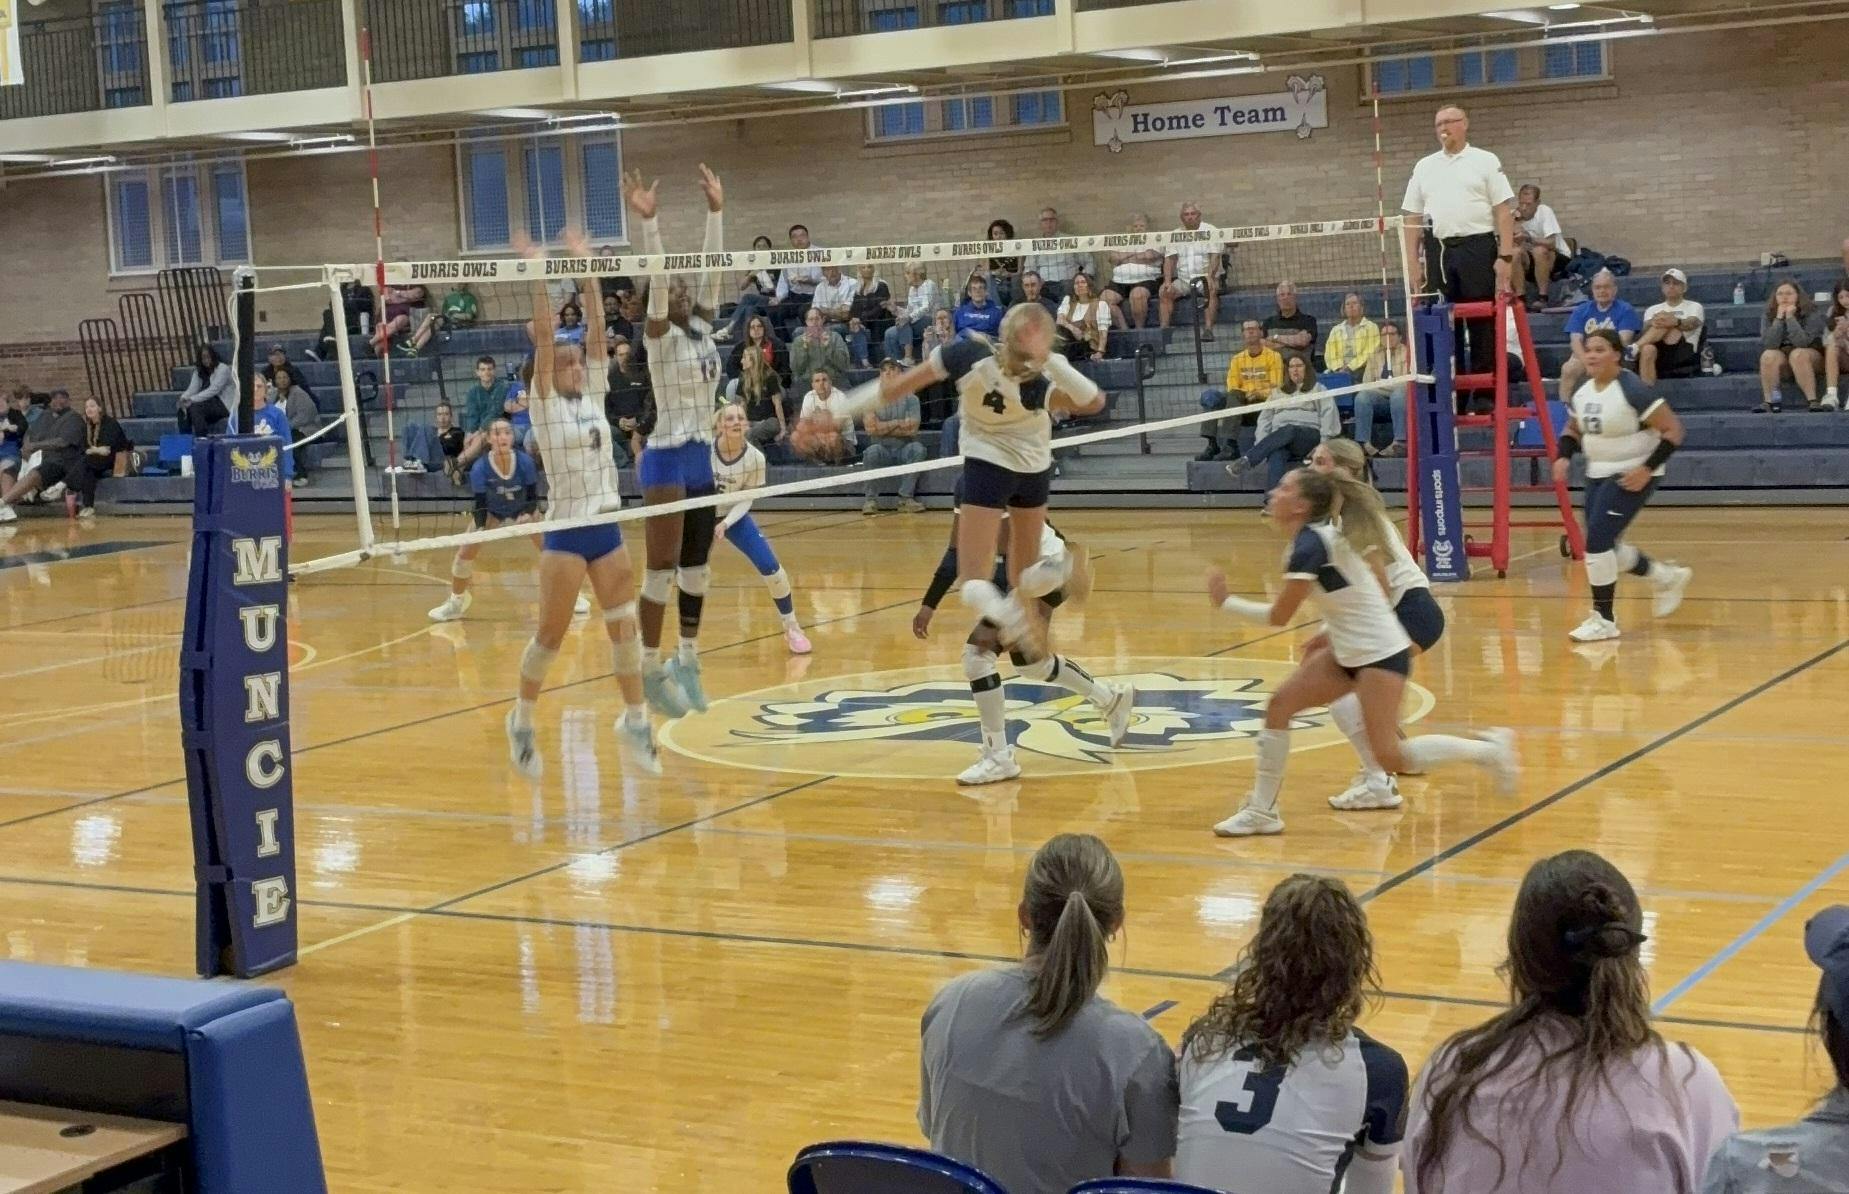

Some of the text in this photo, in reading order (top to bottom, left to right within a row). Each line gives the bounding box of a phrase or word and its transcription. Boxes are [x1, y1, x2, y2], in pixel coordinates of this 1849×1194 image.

[1131, 105, 1287, 134] Home Team
[664, 253, 733, 270] BURRIS OWLS
[770, 249, 832, 264] BURRIS OWLS
[411, 262, 497, 279] BURRIS OWLS
[545, 258, 621, 275] BURRIS OWLS
[982, 389, 1006, 415] 4
[231, 464, 279, 482] BURRIS
[232, 536, 290, 928] MUNCIE
[1214, 1042, 1288, 1135] 3
